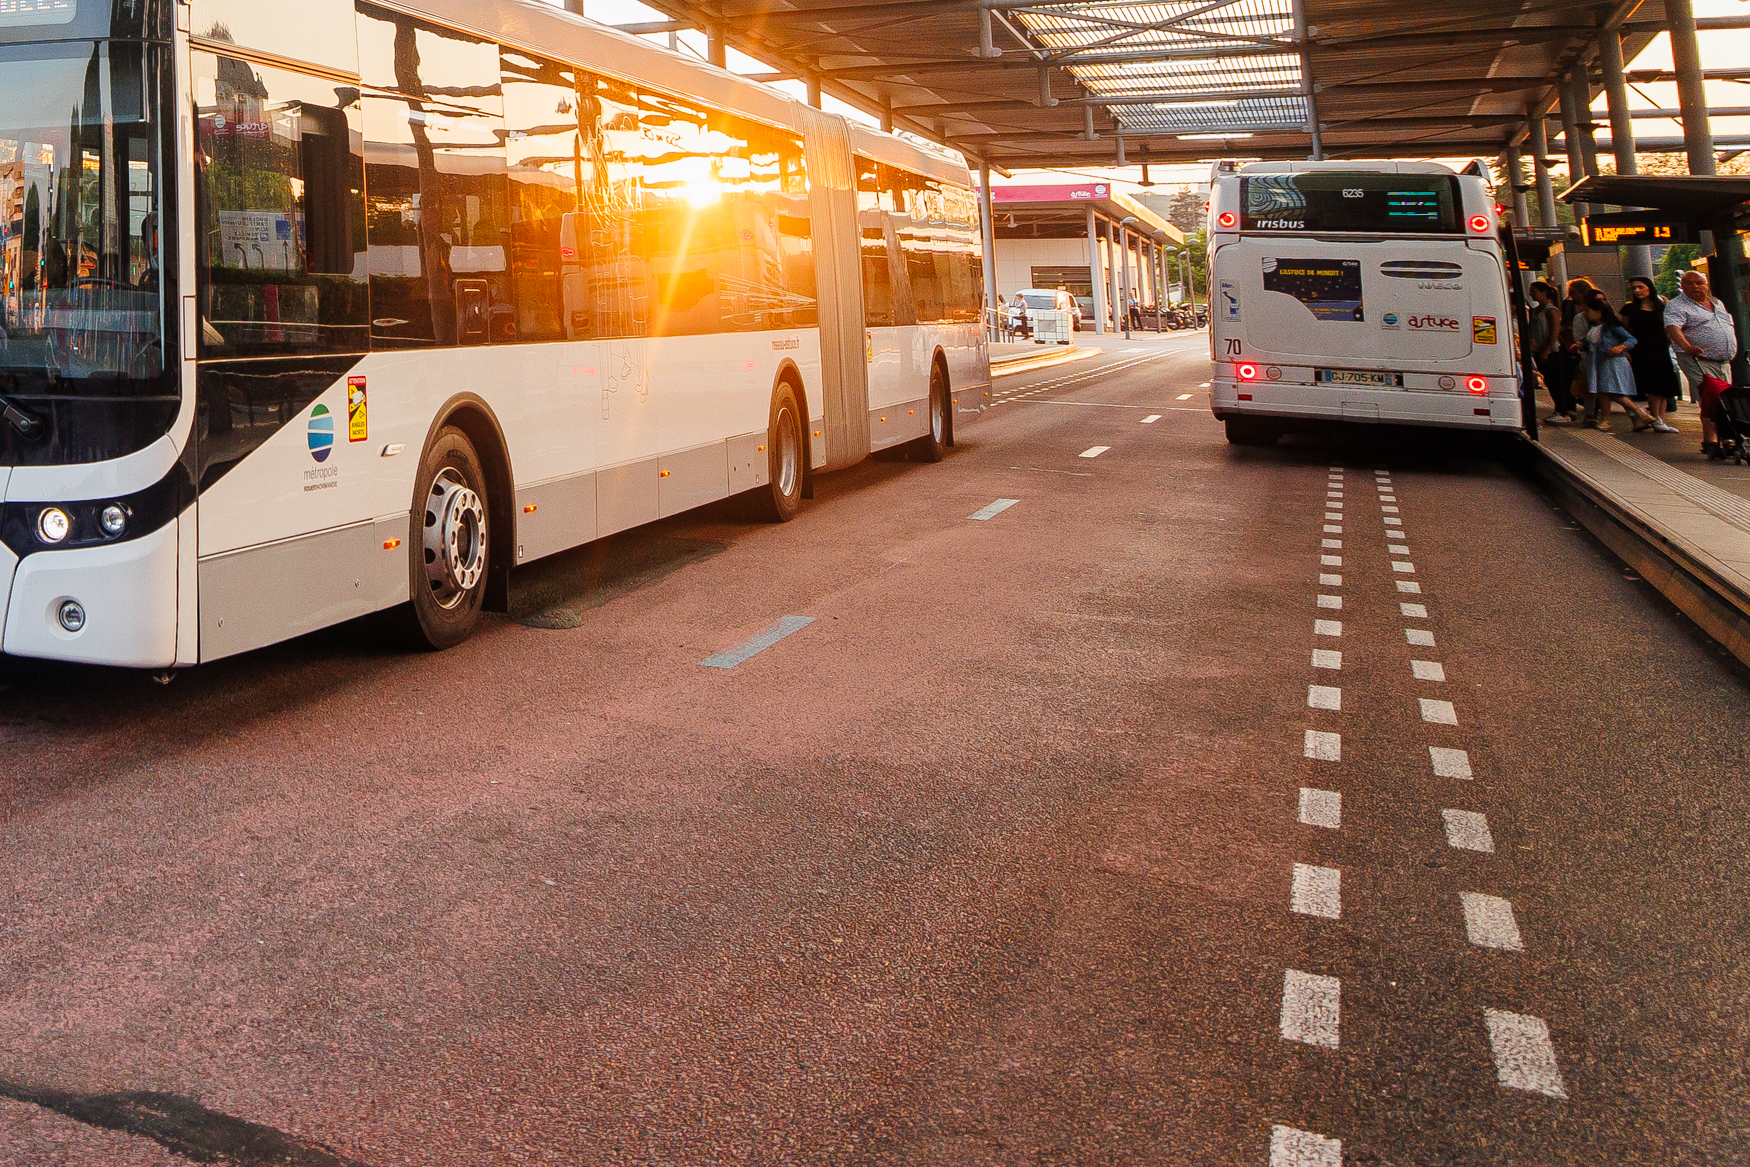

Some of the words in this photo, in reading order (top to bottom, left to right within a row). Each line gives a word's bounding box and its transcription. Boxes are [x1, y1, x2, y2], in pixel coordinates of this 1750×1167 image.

[1342, 189, 1364, 198] 6235
[1256, 219, 1305, 229] irisbus
[1408, 315, 1459, 330] astuce
[1224, 338, 1241, 355] 70
[303, 464, 338, 481] métropole
